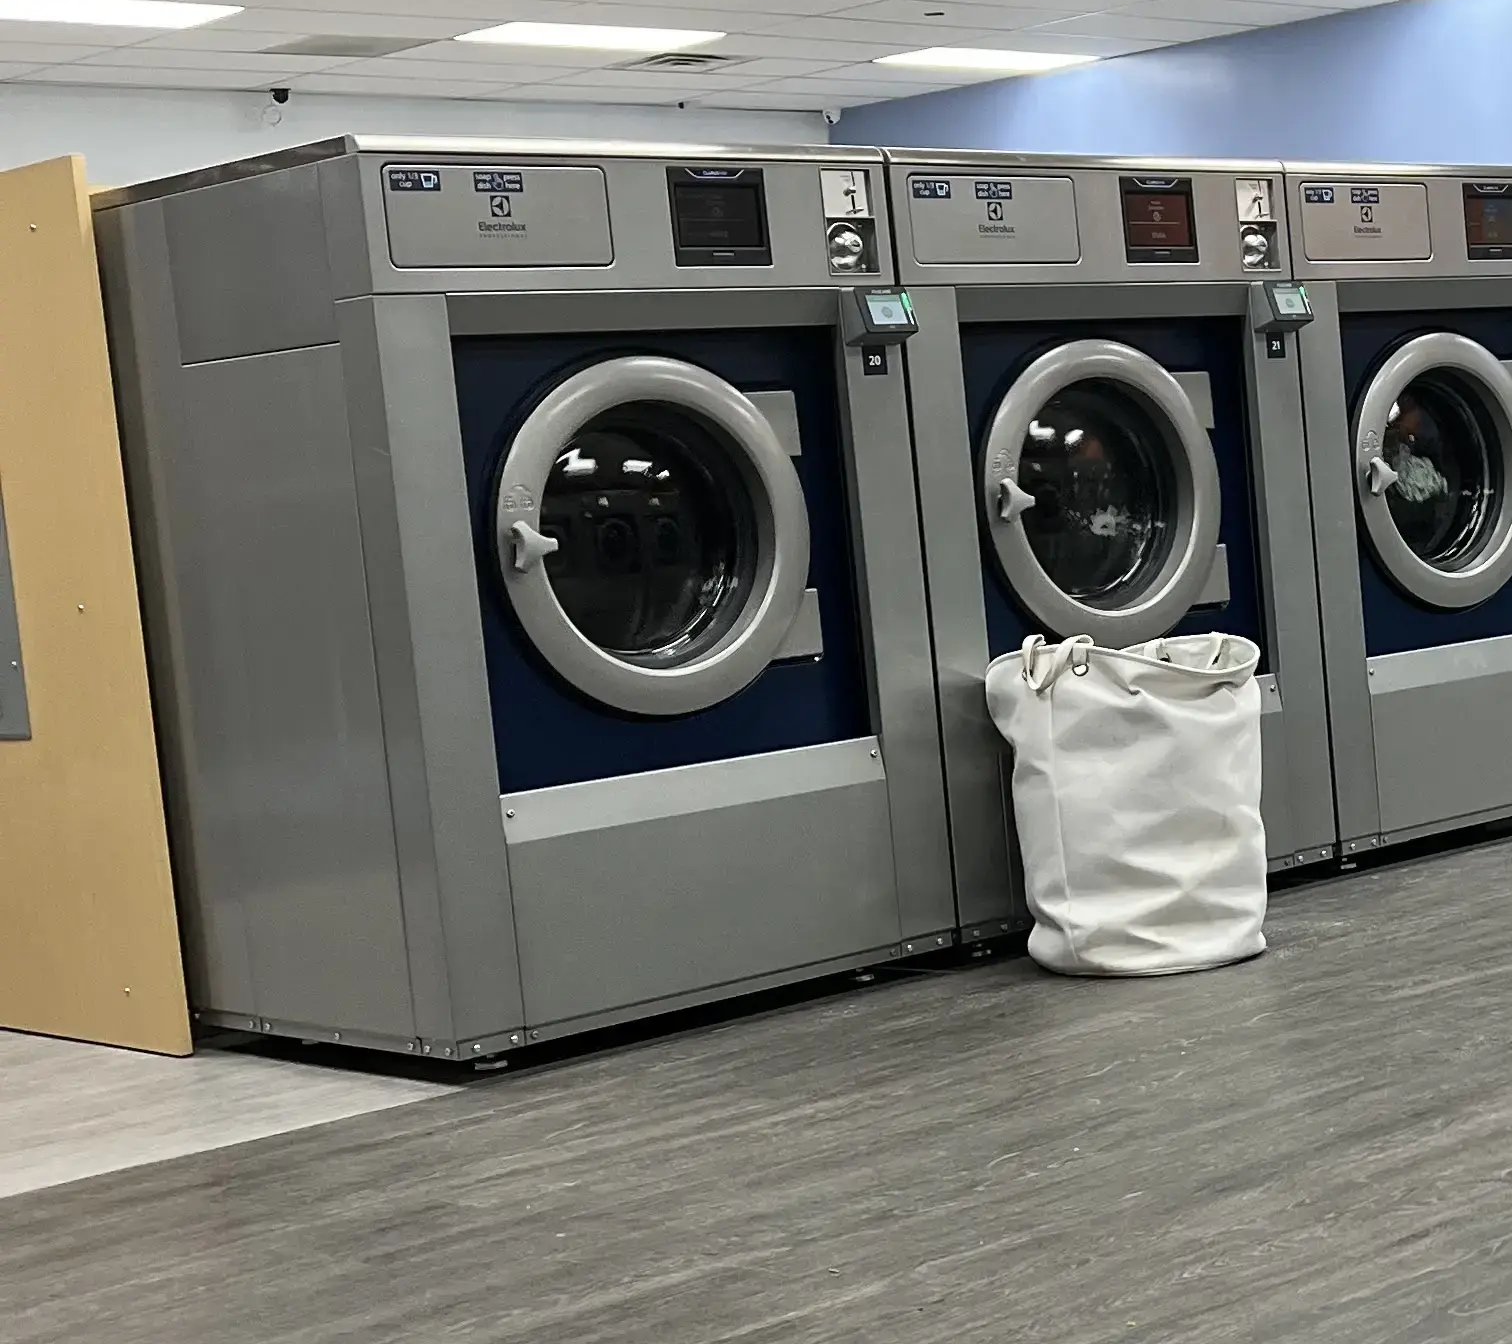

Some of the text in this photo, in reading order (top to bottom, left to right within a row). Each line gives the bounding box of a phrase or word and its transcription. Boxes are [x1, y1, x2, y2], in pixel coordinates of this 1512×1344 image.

[478, 221, 527, 232] Electrolux
[978, 224, 1016, 233] Electrolux
[1272, 340, 1281, 350] 21
[868, 355, 881, 366] 20
